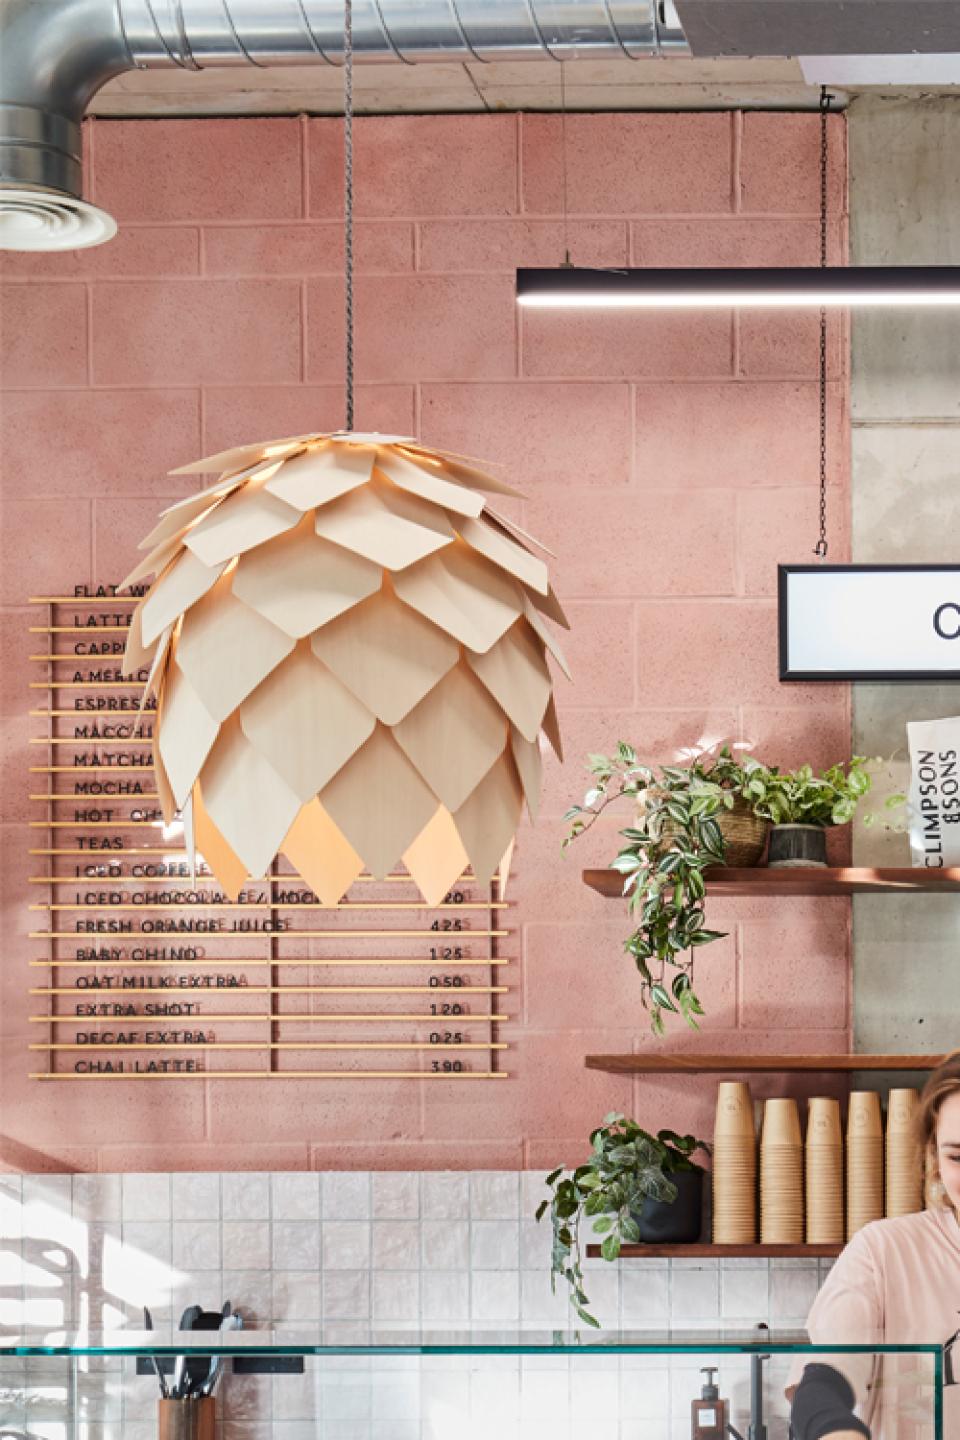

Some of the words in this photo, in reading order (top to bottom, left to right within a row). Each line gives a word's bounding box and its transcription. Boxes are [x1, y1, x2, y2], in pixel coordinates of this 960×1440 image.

[74, 782, 143, 795] MOCHA
[74, 809, 114, 822] HOT
[917, 750, 944, 868] CLIMPSON
[76, 837, 124, 849] TEAS
[76, 893, 122, 904] ICED
[75, 920, 132, 933] FRESH
[141, 919, 217, 933] ORANGE
[76, 948, 121, 960] BABY
[76, 976, 114, 989] OAT
[122, 976, 170, 989] MILK
[179, 976, 240, 988] EXTRA
[75, 1003, 137, 1016] EXTRA
[144, 1003, 195, 1016] SHOT
[76, 1032, 139, 1044] DECAF
[145, 1032, 207, 1044] EXTRA
[74, 1060, 124, 1073] CHAI
[135, 1060, 196, 1073] LATTE
